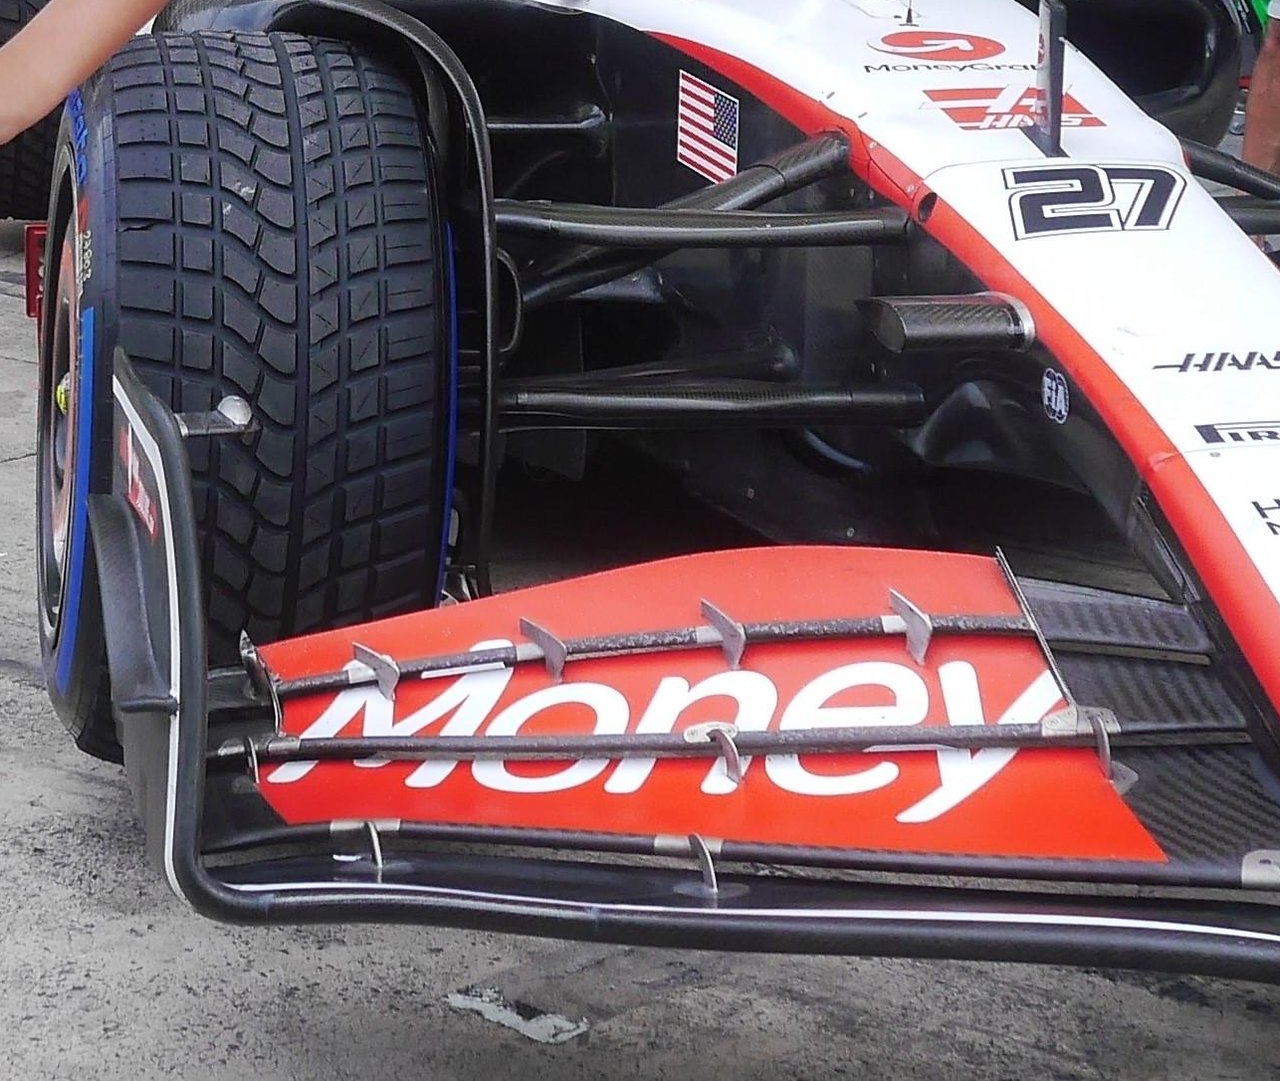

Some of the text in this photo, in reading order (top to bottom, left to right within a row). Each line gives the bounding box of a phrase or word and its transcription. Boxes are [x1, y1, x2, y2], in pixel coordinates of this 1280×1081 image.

[1002, 163, 1188, 241] 27
[1043, 370, 1069, 420] FIA
[267, 637, 1065, 824] Money
